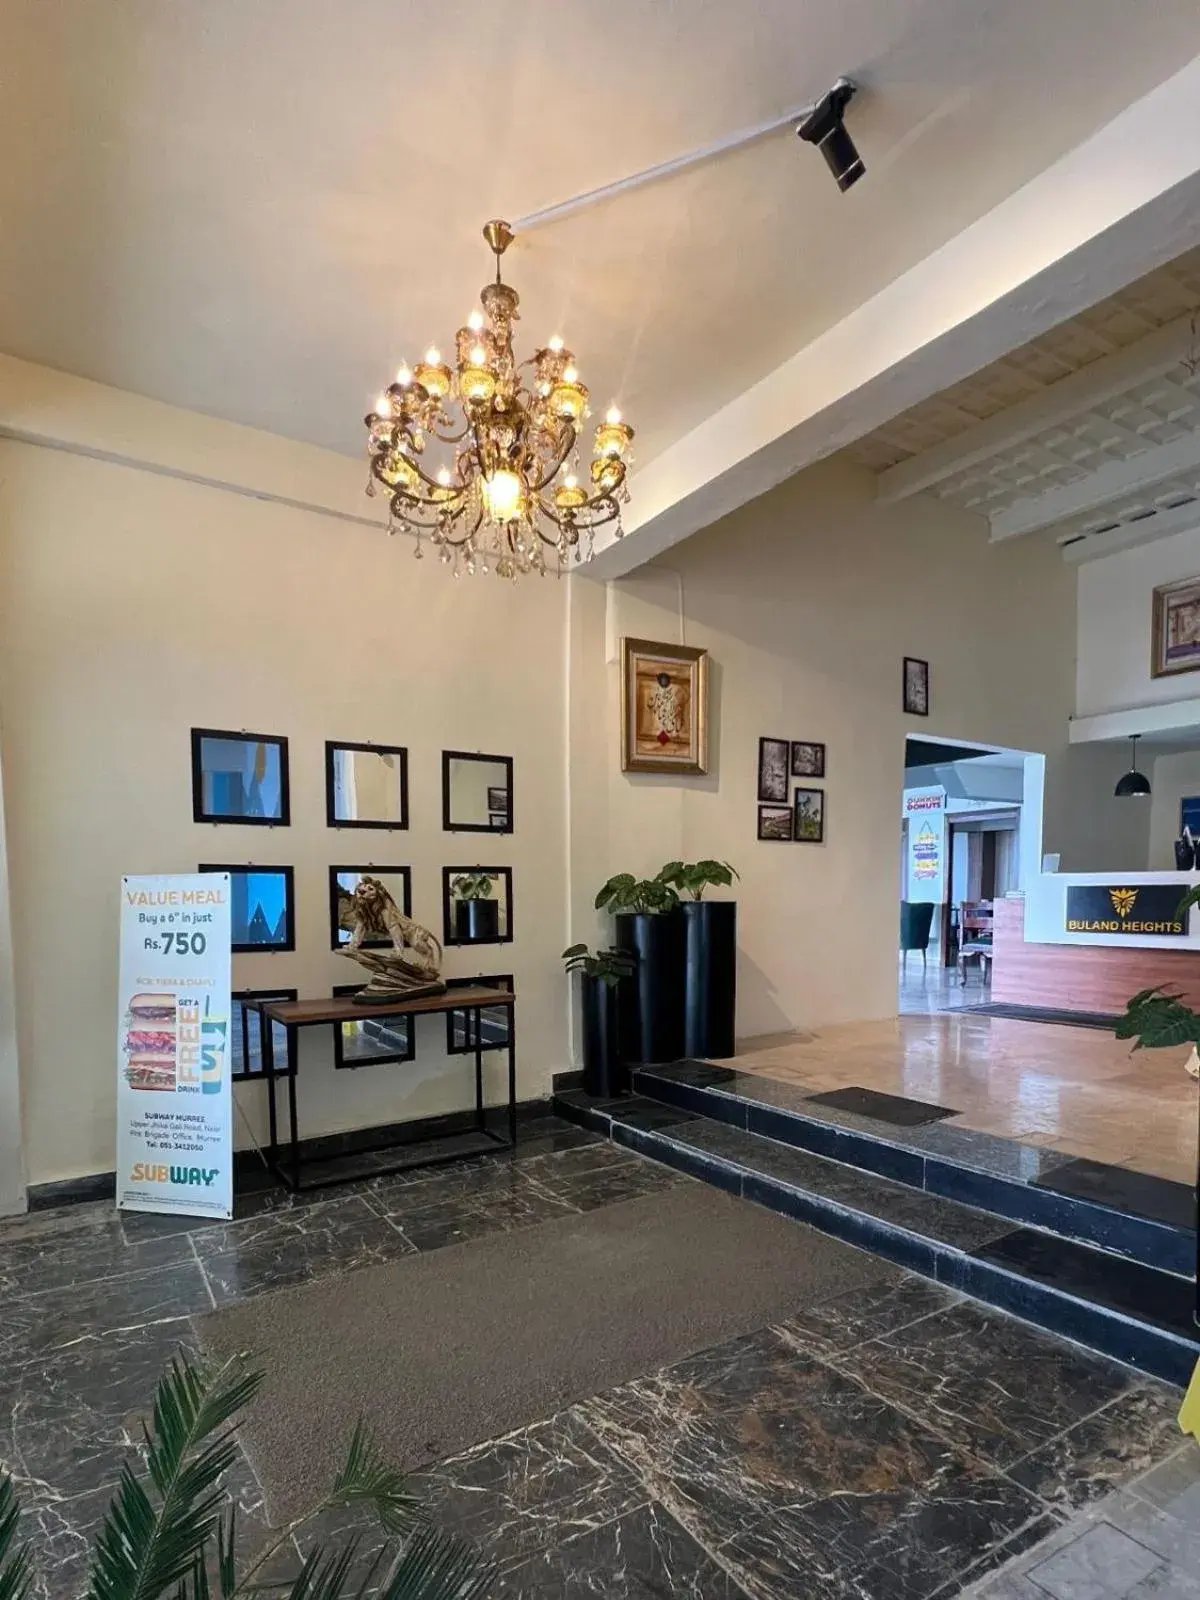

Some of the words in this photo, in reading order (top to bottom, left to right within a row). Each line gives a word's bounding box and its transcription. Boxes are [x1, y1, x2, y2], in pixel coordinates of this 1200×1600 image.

[907, 802, 941, 811] DONUTS
[127, 891, 178, 906] VALUE
[182, 889, 226, 905] MEAL
[138, 912, 157, 925] Buy
[160, 915, 166, 923] a
[182, 913, 191, 923] in
[192, 912, 213, 925] just
[1068, 920, 1119, 931] BULAND
[1121, 921, 1183, 933] HEIGHTS
[179, 1006, 200, 1083] FREE
[177, 1085, 200, 1093] DRINK
[144, 1112, 174, 1120] SUBWAY
[130, 1163, 221, 1187] SUBWAY
